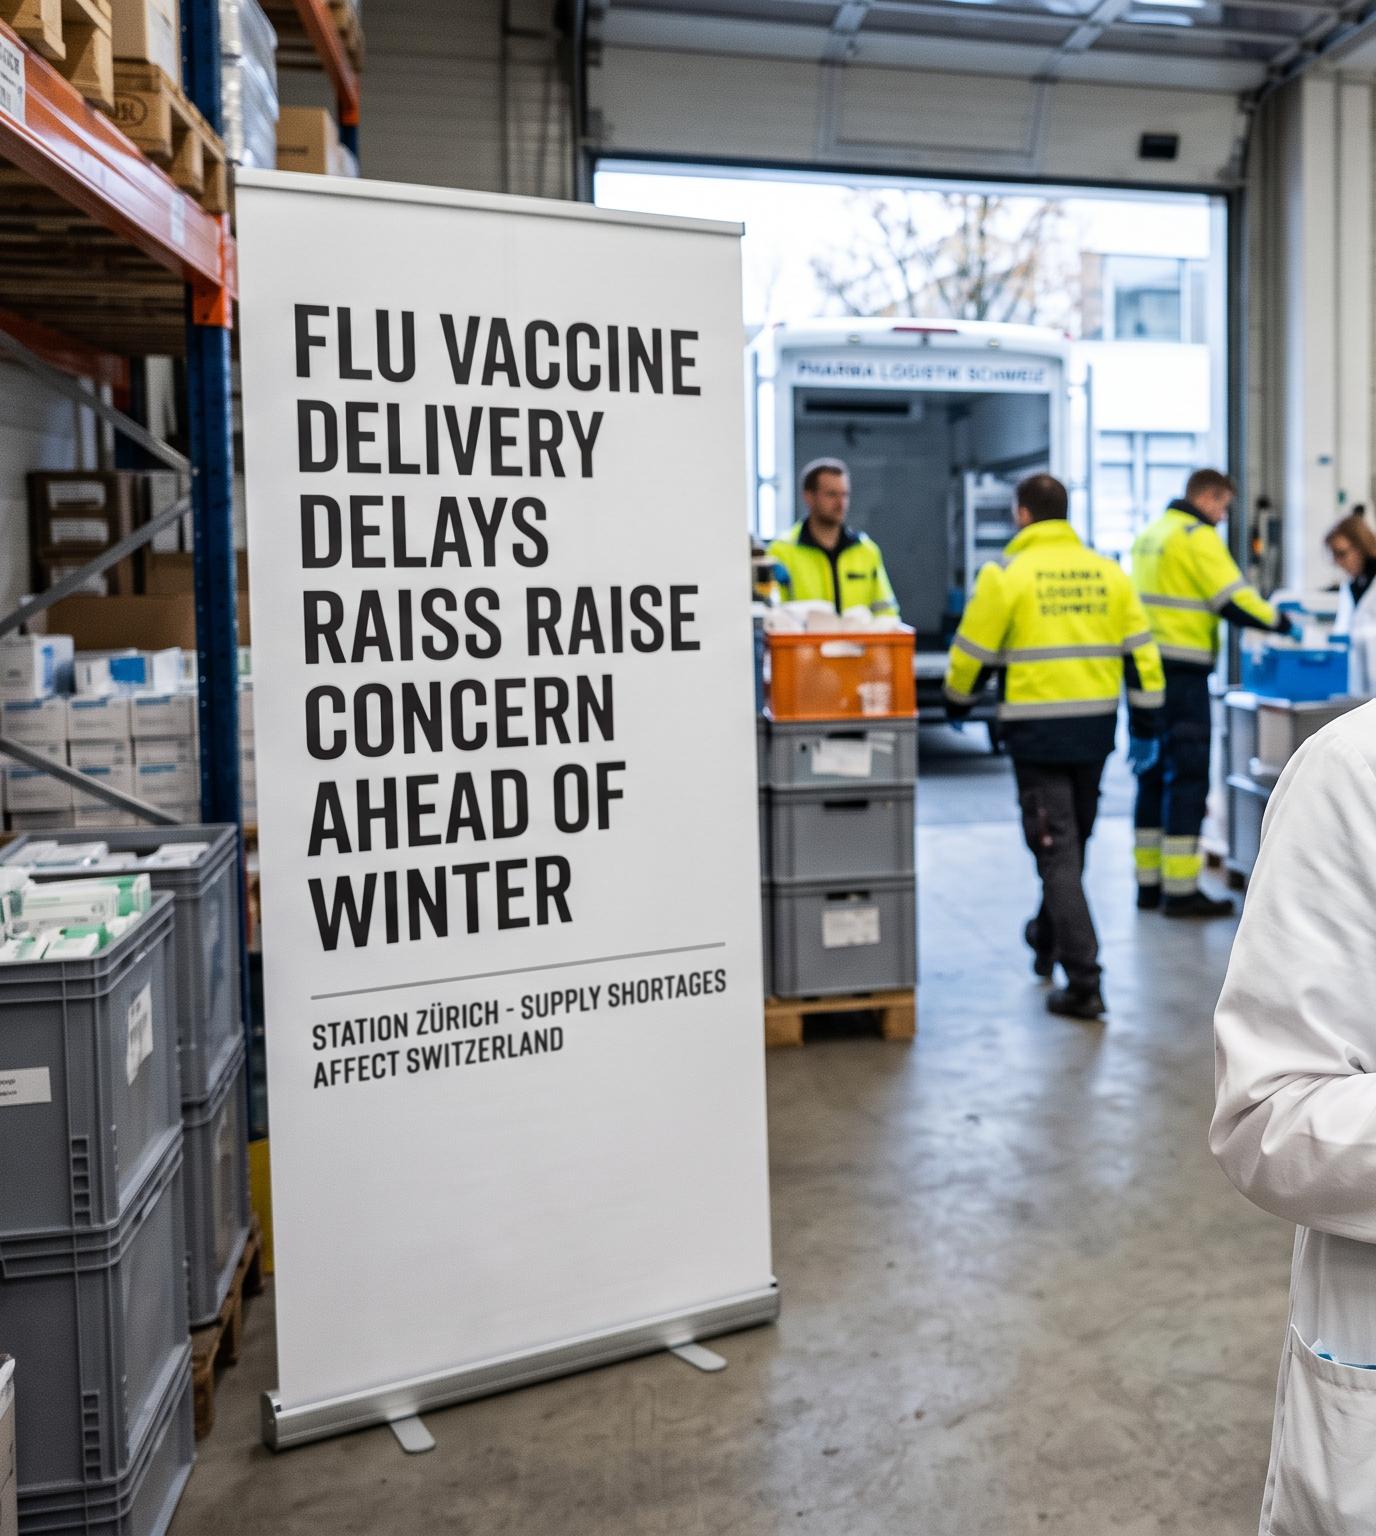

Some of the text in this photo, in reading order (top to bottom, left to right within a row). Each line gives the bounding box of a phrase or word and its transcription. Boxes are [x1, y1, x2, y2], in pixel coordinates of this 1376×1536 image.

[294, 303, 701, 397] FLU VACCINE
[798, 359, 873, 377] PHARMA
[880, 362, 958, 380] LOGISTIK
[296, 399, 604, 478] DELIVERY
[300, 494, 549, 569] DELAYS
[302, 584, 701, 665] RAISS RAISE
[305, 673, 615, 761] CONCERN
[307, 760, 627, 857] AHEAD OF
[307, 855, 573, 952] WINTER
[312, 1012, 409, 1051] STATION
[416, 999, 499, 1036] ZÜRICH
[520, 985, 601, 1020] SUPPLY
[607, 968, 727, 1008] SHORTAGES
[313, 1026, 564, 1090] AFFECT SWITZERLAND
